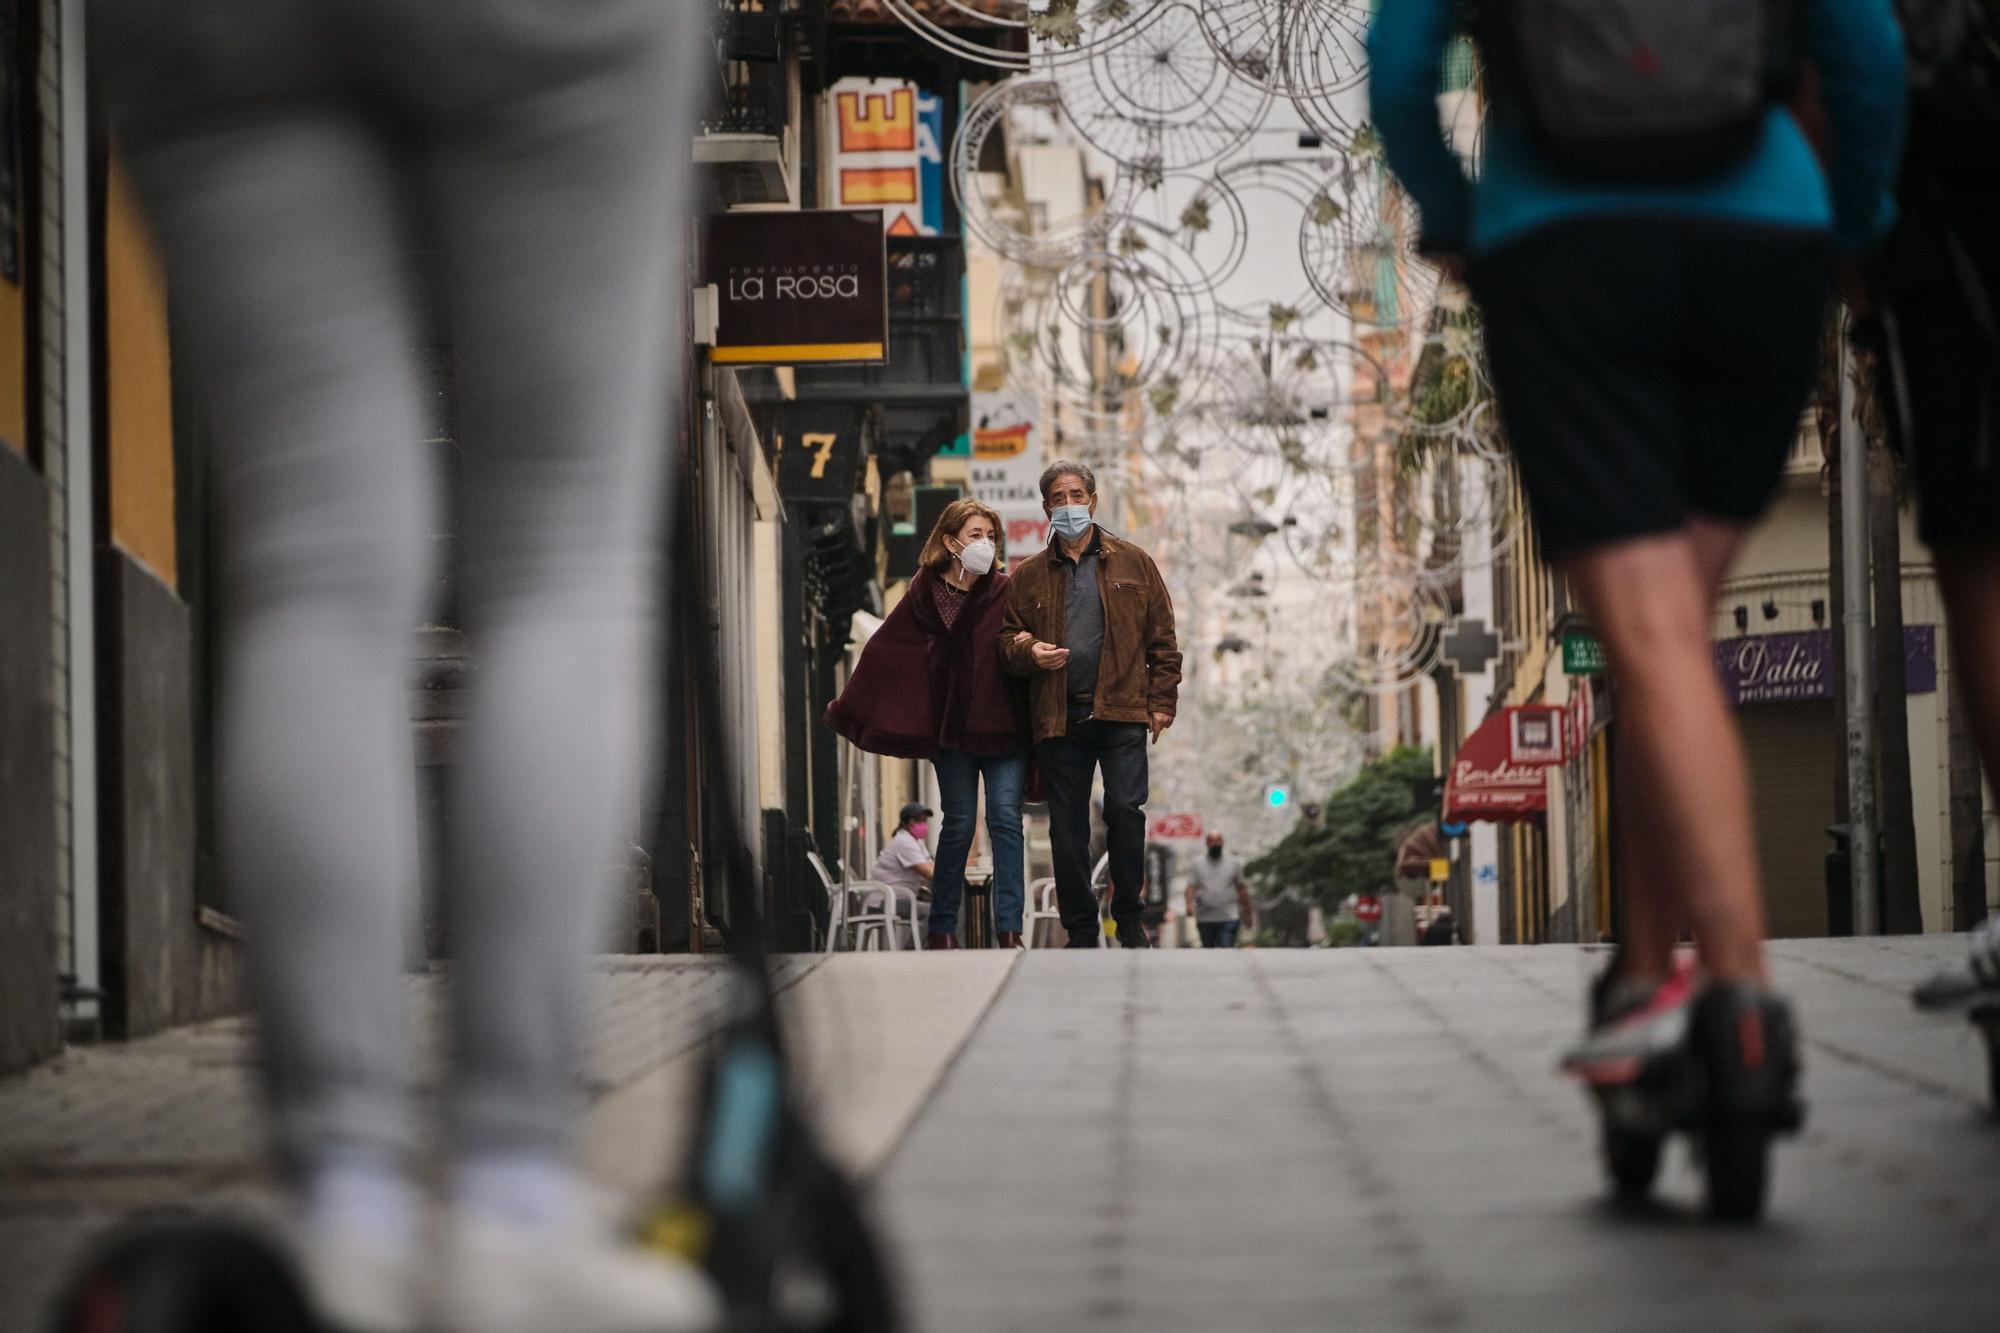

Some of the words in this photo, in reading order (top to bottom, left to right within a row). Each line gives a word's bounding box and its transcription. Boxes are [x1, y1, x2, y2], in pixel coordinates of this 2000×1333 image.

[801, 432, 837, 479] 7
[972, 469, 1007, 482] BAR
[976, 484, 1036, 501] ETERÍA
[1739, 641, 1821, 686] Dalia
